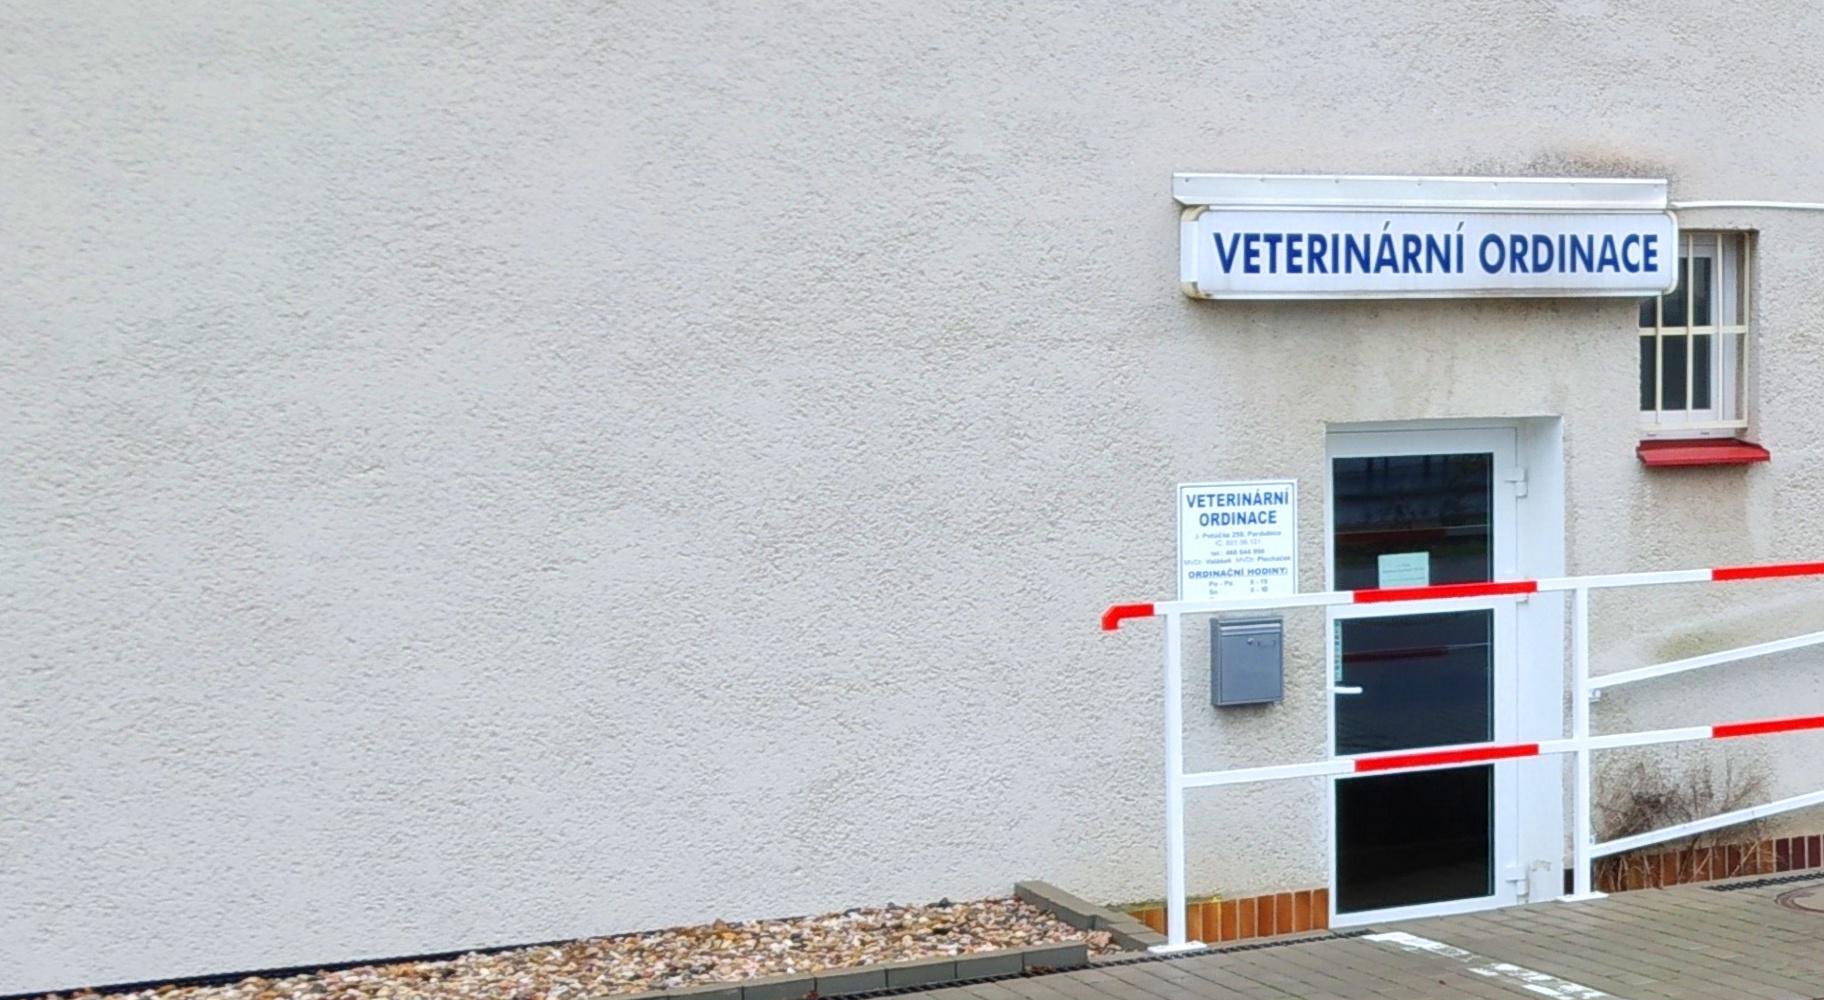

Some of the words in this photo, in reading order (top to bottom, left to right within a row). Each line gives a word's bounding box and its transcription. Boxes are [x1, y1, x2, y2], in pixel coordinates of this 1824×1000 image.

[1212, 220, 1465, 275] VETERINÁRNÍ
[1478, 232, 1659, 274] ORDINACE
[1186, 488, 1289, 508] VETERINÁRNÍ
[1199, 510, 1278, 527] ORDINACE
[1188, 567, 1244, 580] ORDINAČNÍ
